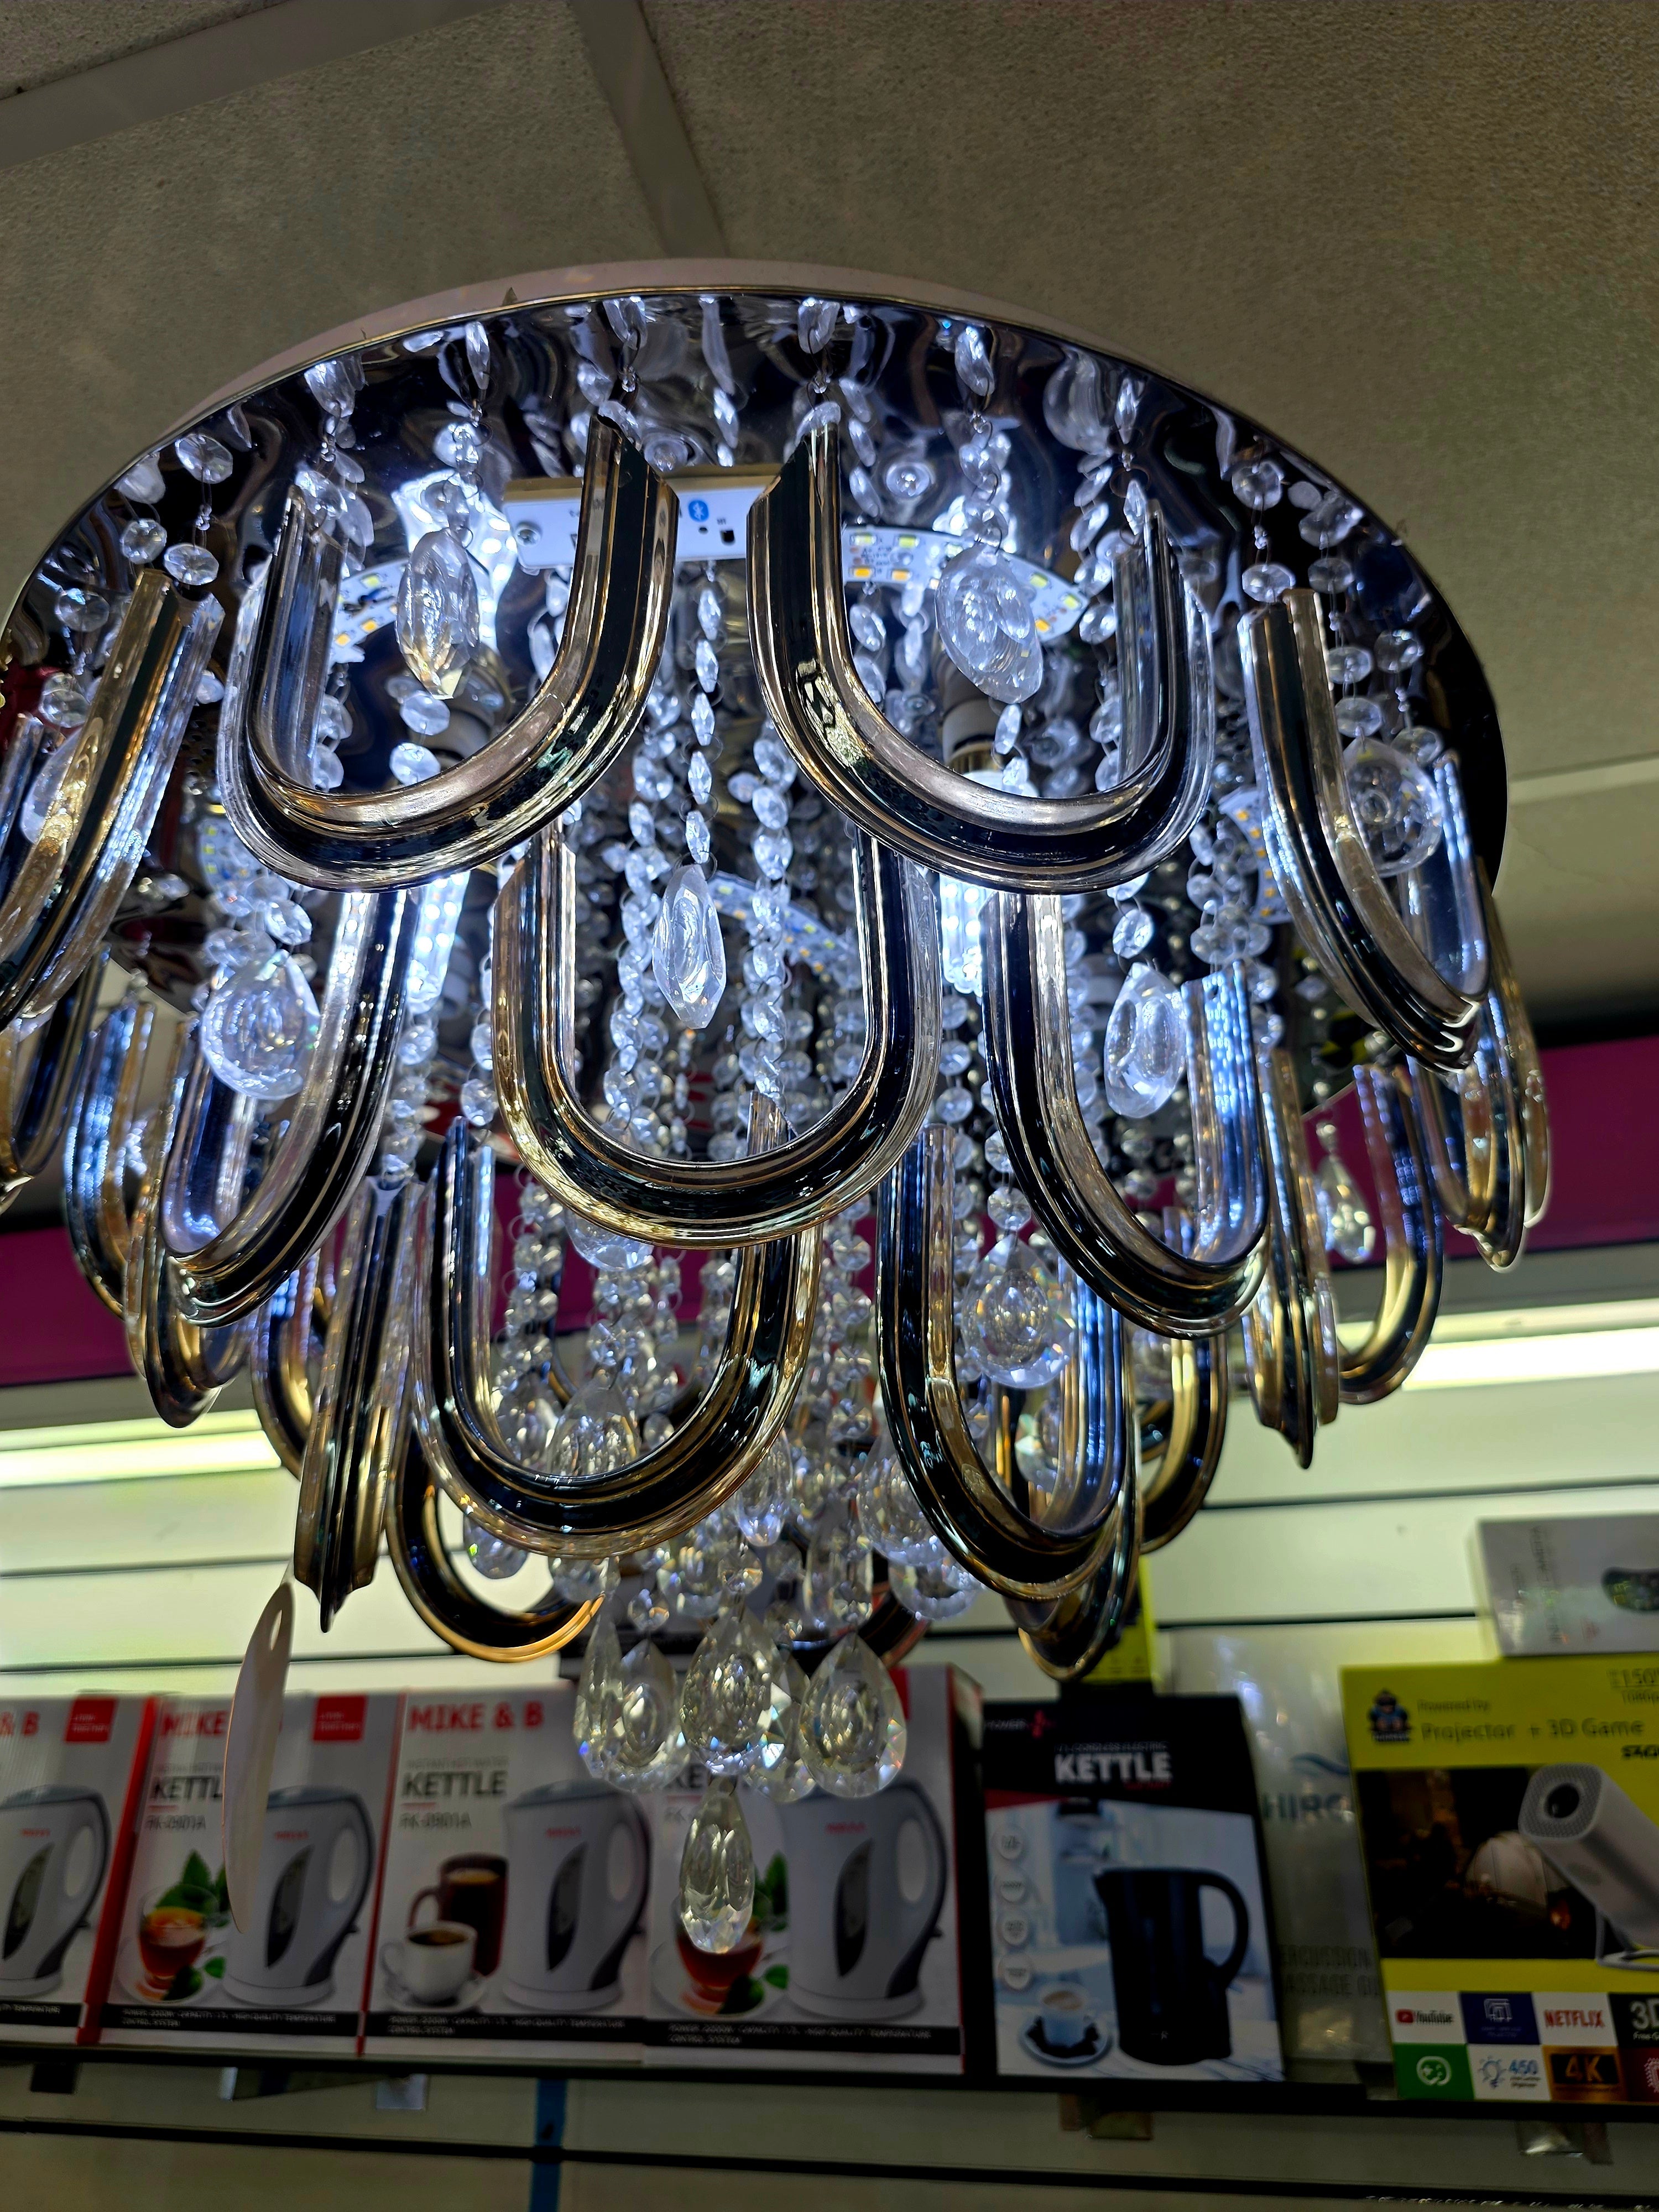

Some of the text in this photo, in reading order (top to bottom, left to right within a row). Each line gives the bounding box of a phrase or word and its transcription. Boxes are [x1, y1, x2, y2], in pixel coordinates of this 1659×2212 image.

[24, 1710, 39, 1735] B
[409, 1700, 544, 1731] MIKE & B
[1421, 1721, 1516, 1743] Projector
[1547, 1718, 1577, 1738] 3D
[1581, 1717, 1645, 1738] Game
[1054, 1752, 1173, 1785] KETTLE
[152, 1775, 224, 1798] KETTL
[403, 1770, 508, 1796] KETTLE
[1279, 1944, 1370, 1968] ERCUSSION
[1544, 2008, 1605, 2027] NETFLIX
[1565, 2054, 1604, 2083] 4K
